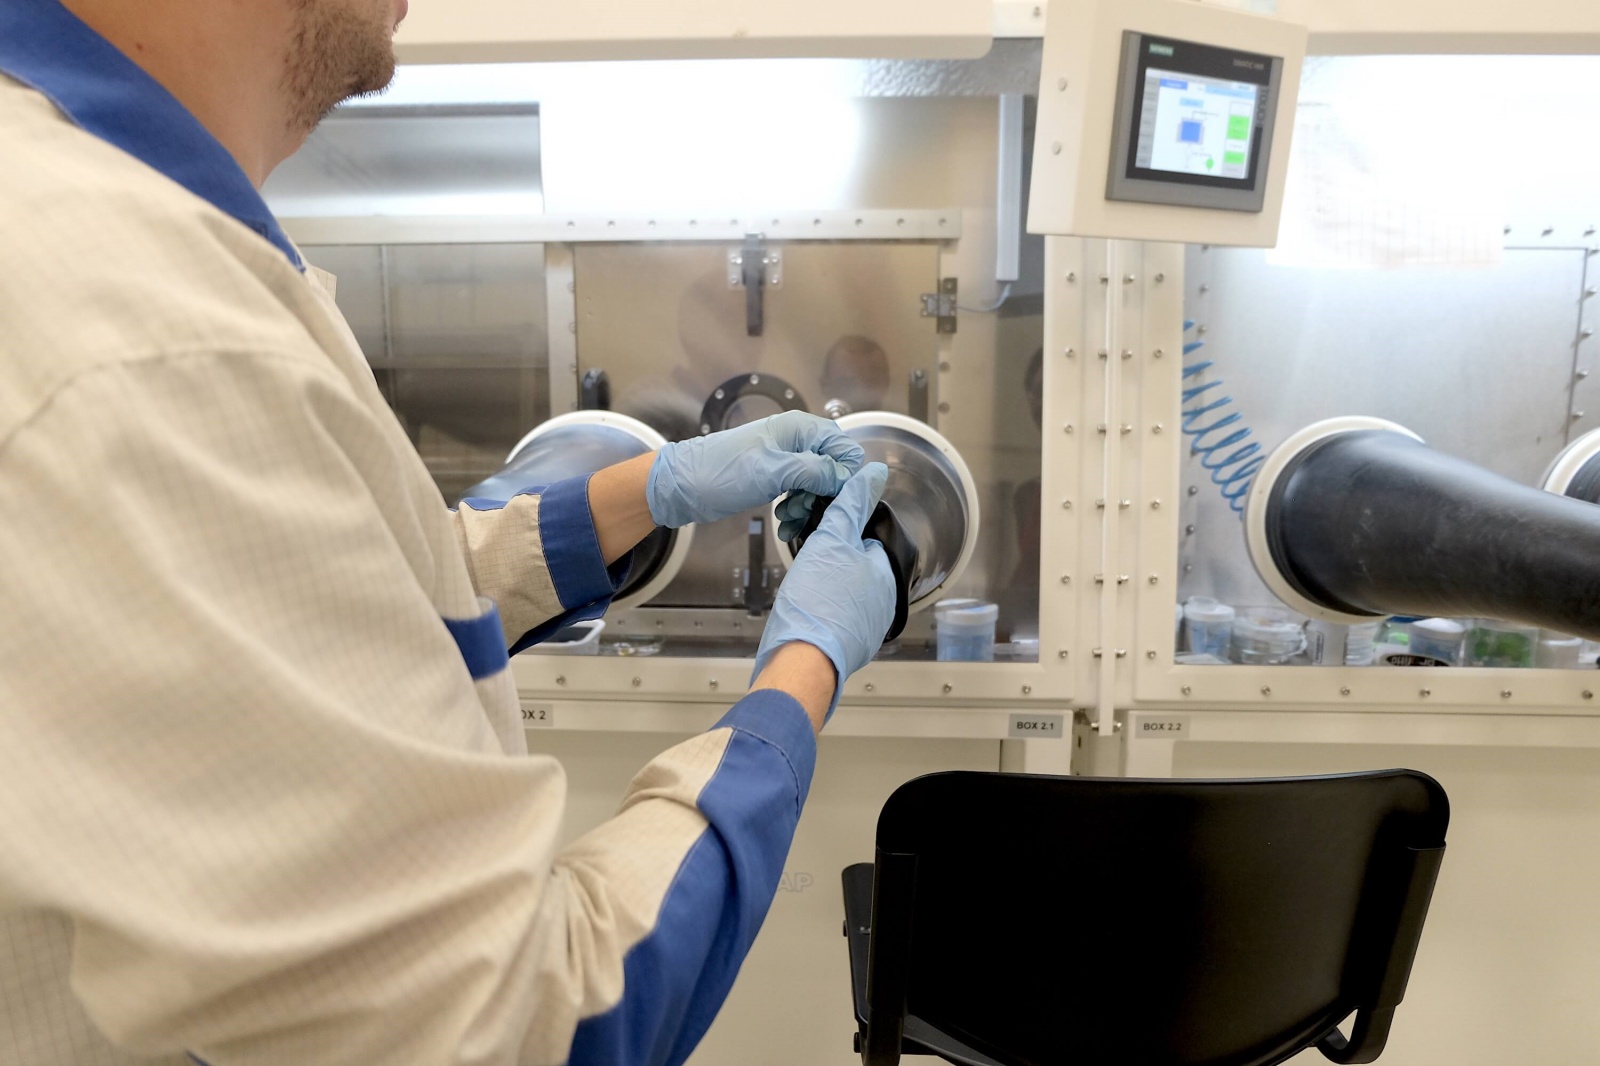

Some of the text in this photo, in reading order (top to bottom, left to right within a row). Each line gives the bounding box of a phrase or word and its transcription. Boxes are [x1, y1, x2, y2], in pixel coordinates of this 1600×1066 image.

[539, 710, 546, 720] 2
[1016, 721, 1054, 730] BOX 2.1
[1143, 722, 1182, 731] BOX 2.2
